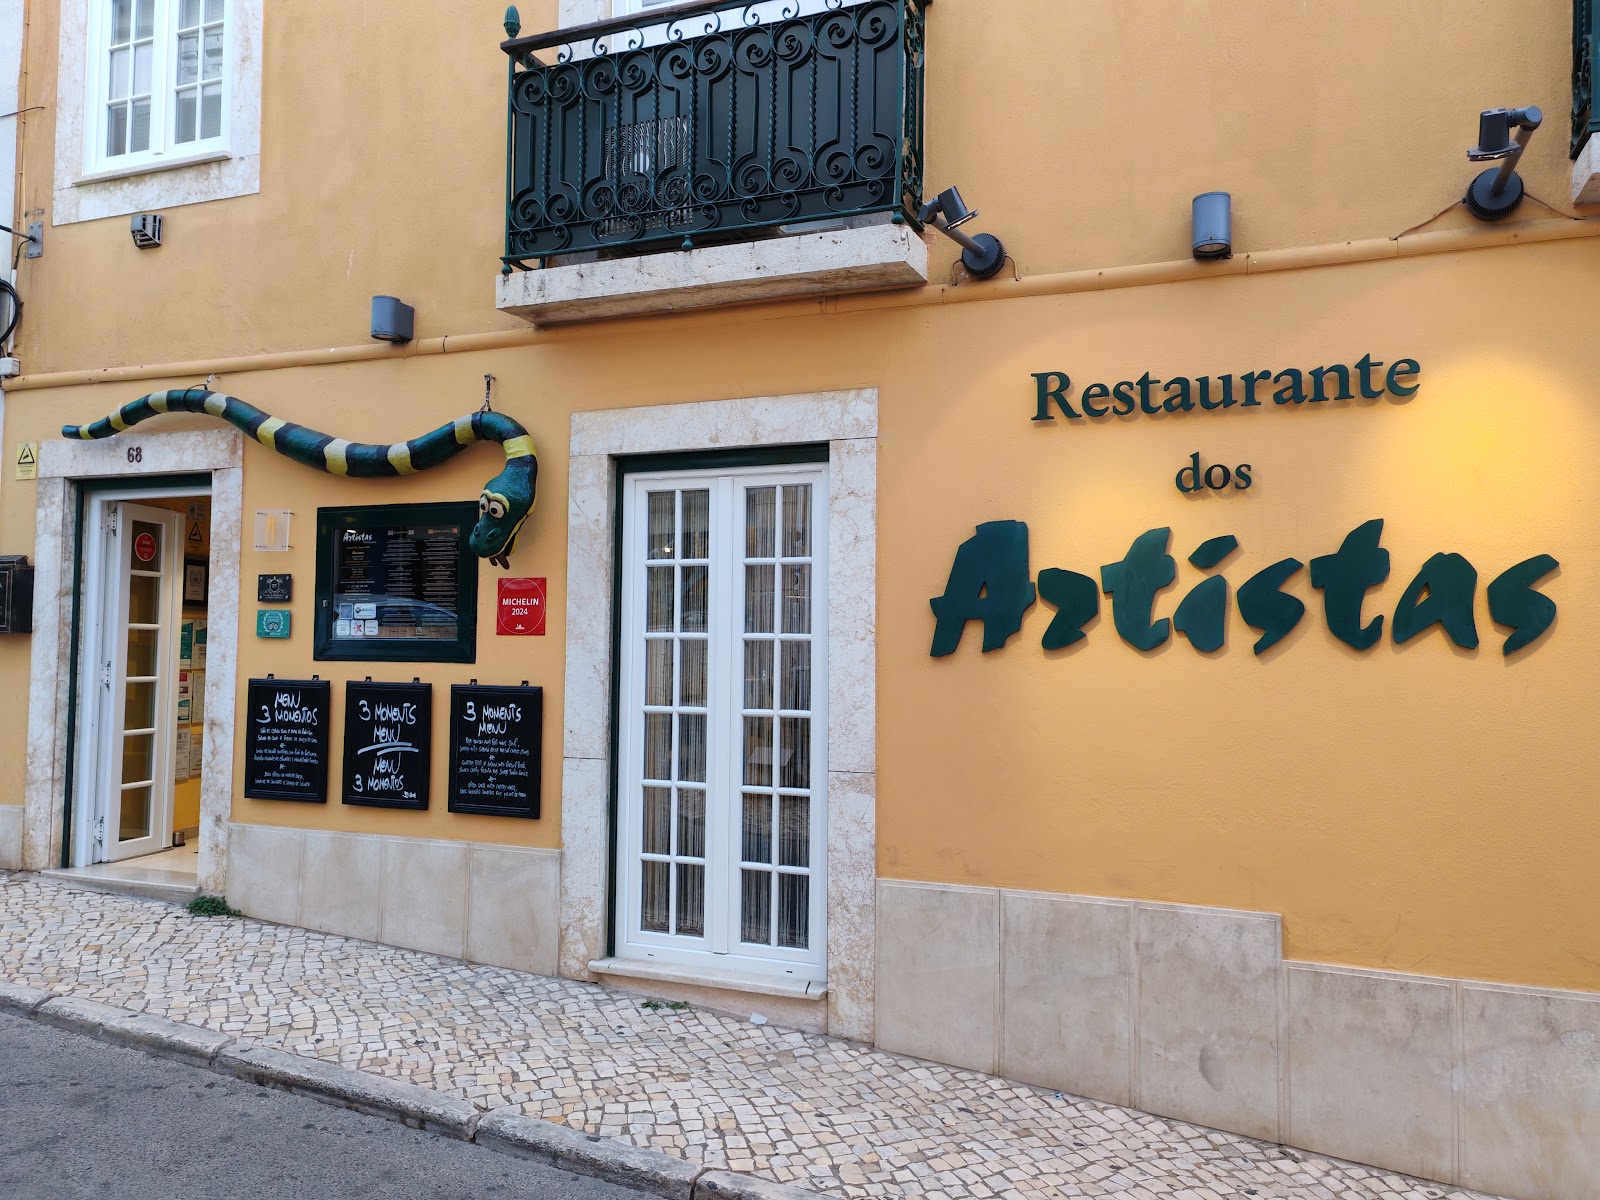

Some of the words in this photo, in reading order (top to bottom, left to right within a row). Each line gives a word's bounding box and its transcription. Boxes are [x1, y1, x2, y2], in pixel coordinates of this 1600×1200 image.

[1030, 352, 1421, 422] Restaurante
[127, 446, 143, 464] 68
[1174, 452, 1252, 493] dos
[929, 518, 1560, 658] Artistas
[502, 598, 539, 606] MICHELIN
[511, 608, 528, 616] 2024
[274, 690, 301, 709] MENU
[256, 704, 271, 724] 3
[358, 699, 371, 721] 3
[462, 701, 477, 722] 3
[373, 724, 401, 743] MENU
[372, 752, 402, 776] MENU
[352, 774, 363, 793] 3
